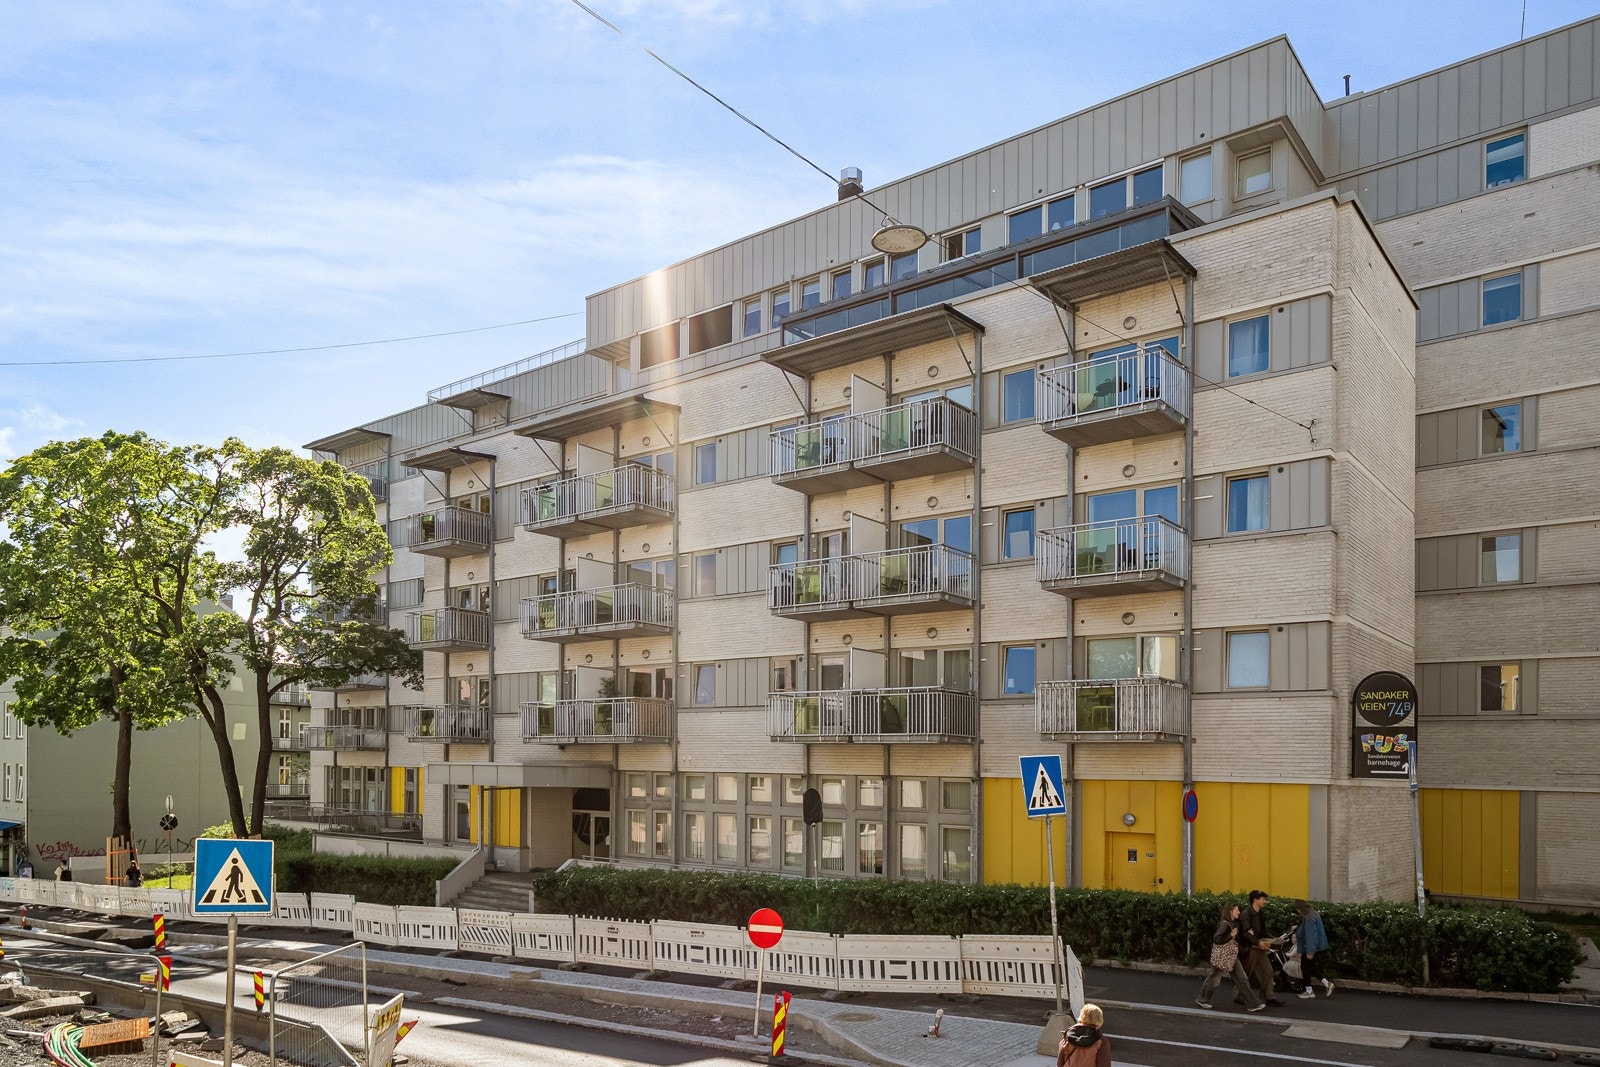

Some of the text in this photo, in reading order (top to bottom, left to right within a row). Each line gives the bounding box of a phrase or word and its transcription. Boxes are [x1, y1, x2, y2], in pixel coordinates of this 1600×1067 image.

[1360, 691, 1409, 700] SANDAKER
[1360, 701, 1412, 717] VEIEN 74B
[1367, 759, 1401, 767] barnehage
